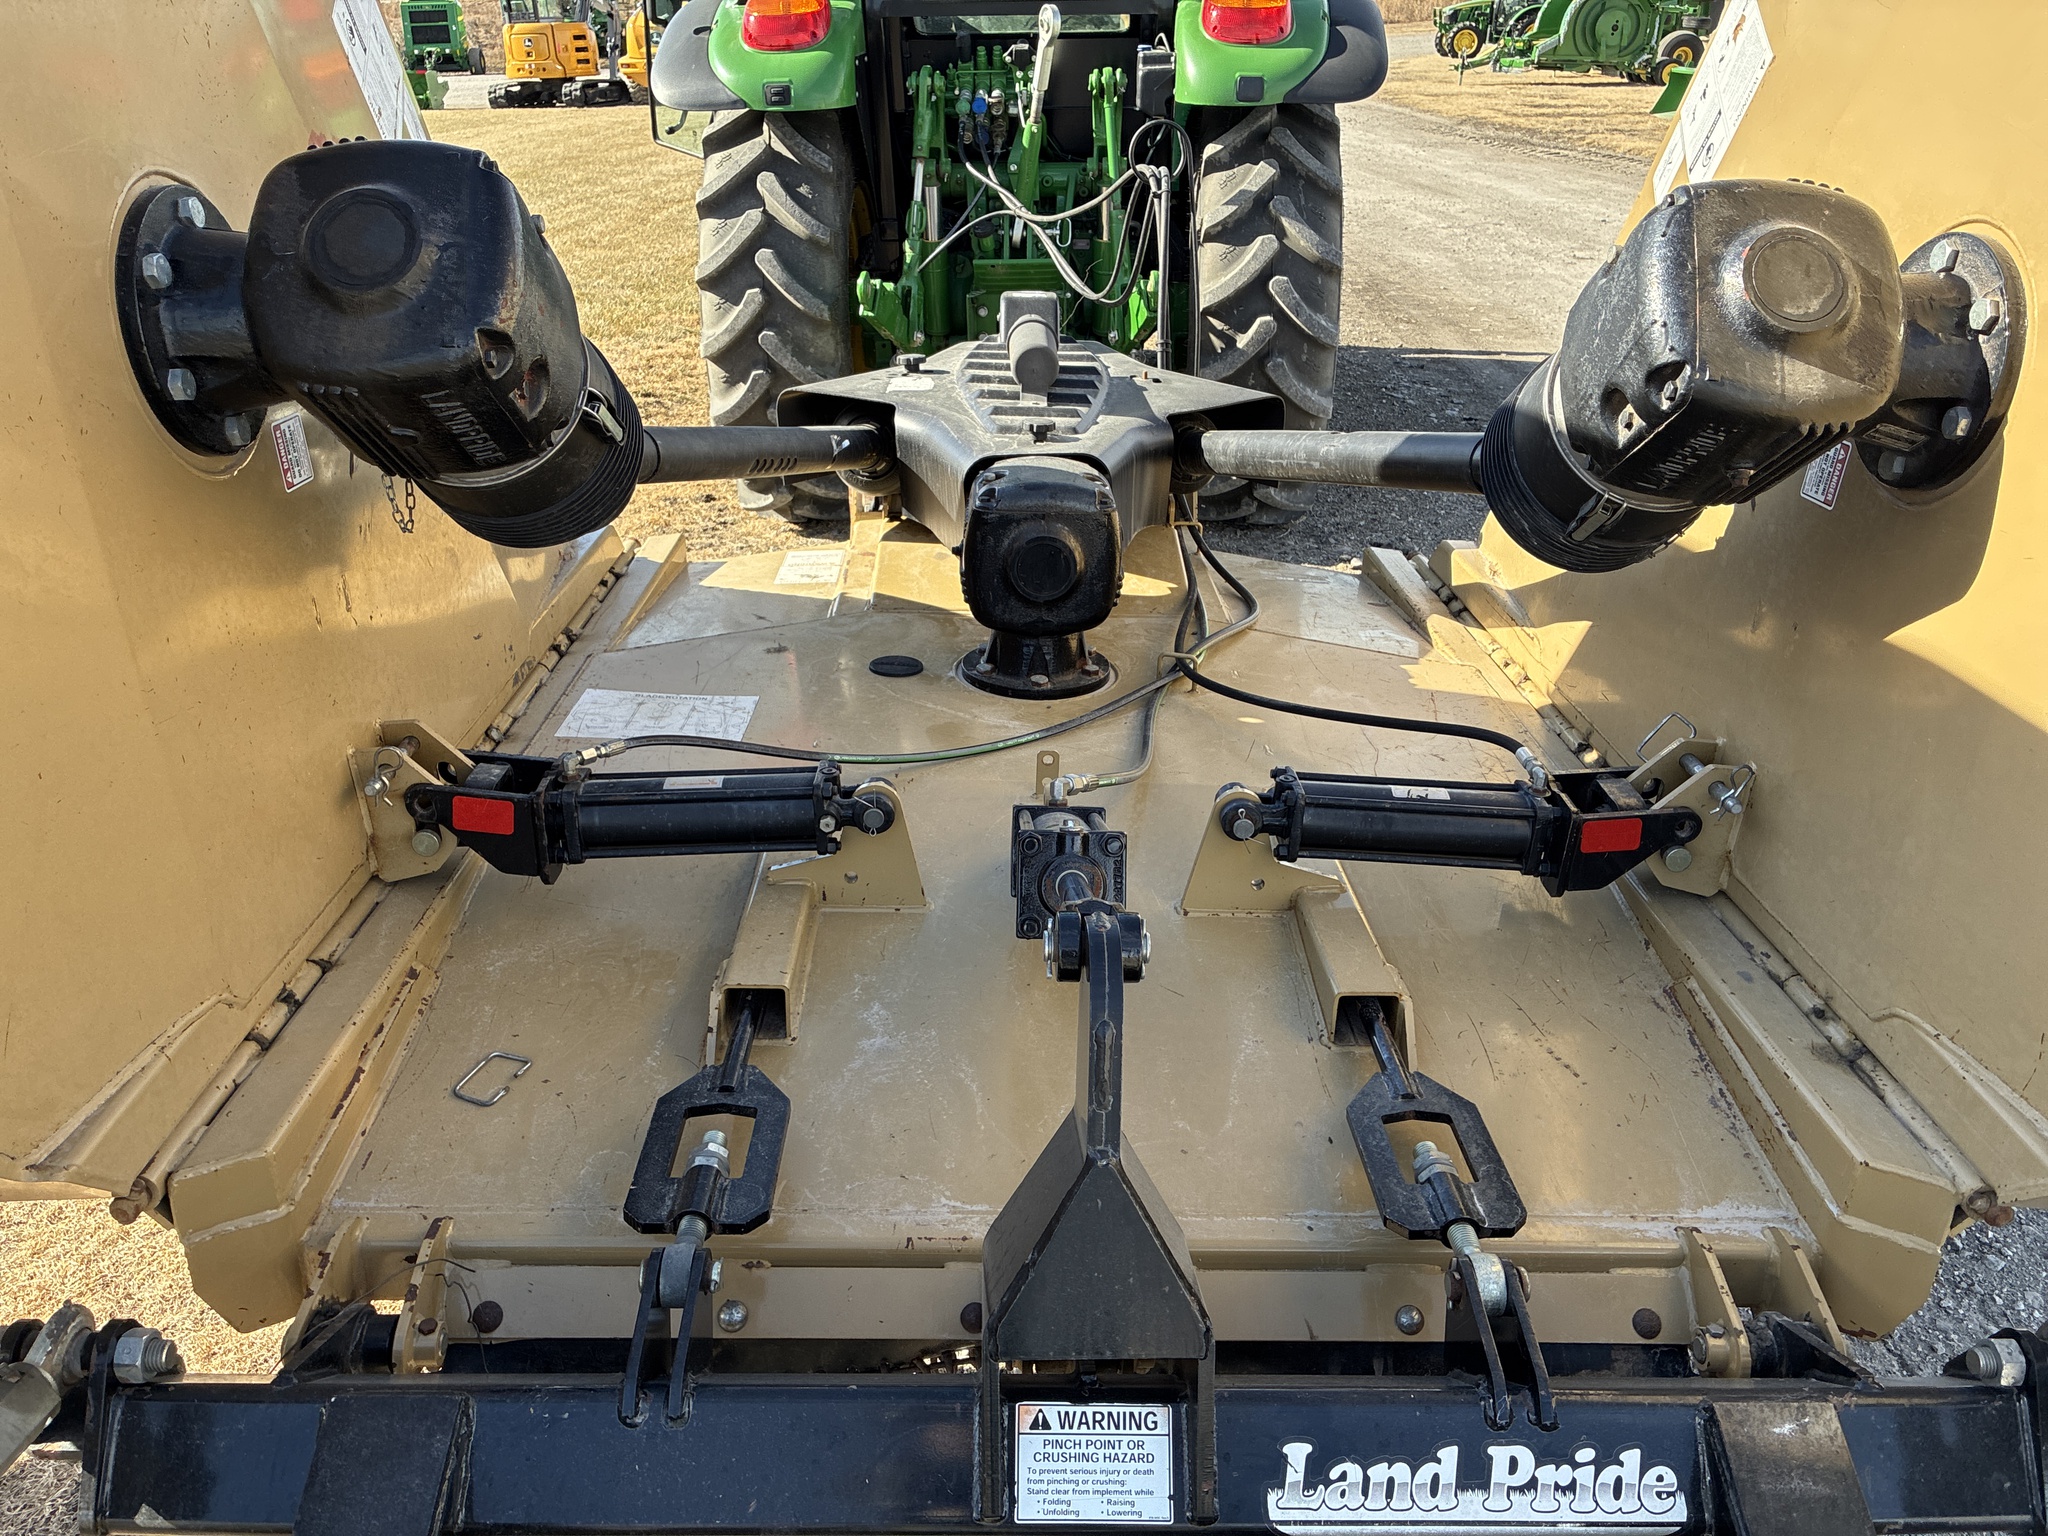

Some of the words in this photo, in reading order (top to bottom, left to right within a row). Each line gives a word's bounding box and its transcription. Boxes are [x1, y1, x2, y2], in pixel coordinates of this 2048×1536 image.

[275, 429, 289, 470] DANGER
[1829, 447, 1839, 469] GUARD
[1813, 467, 1826, 495] OPERATE
[1820, 470, 1832, 497] MISSING
[1826, 463, 1842, 501] DANGER
[1057, 1411, 1158, 1431] WARNING
[1044, 1439, 1081, 1449] PINCH
[1086, 1440, 1123, 1450] POINT
[1127, 1440, 1145, 1450] OR
[1034, 1452, 1099, 1463] CRUSHING
[1104, 1453, 1154, 1463] HAZARD
[1047, 1478, 1079, 1487] pinching
[1092, 1479, 1127, 1487] crushing:
[1278, 1442, 1459, 1512] Land
[1487, 1445, 1678, 1514] Pride
[1093, 1489, 1132, 1497] implement
[1043, 1499, 1071, 1507] Folding
[1107, 1499, 1135, 1508] Raising
[1043, 1509, 1079, 1517] Unfolding
[1107, 1509, 1142, 1518] Lowering
